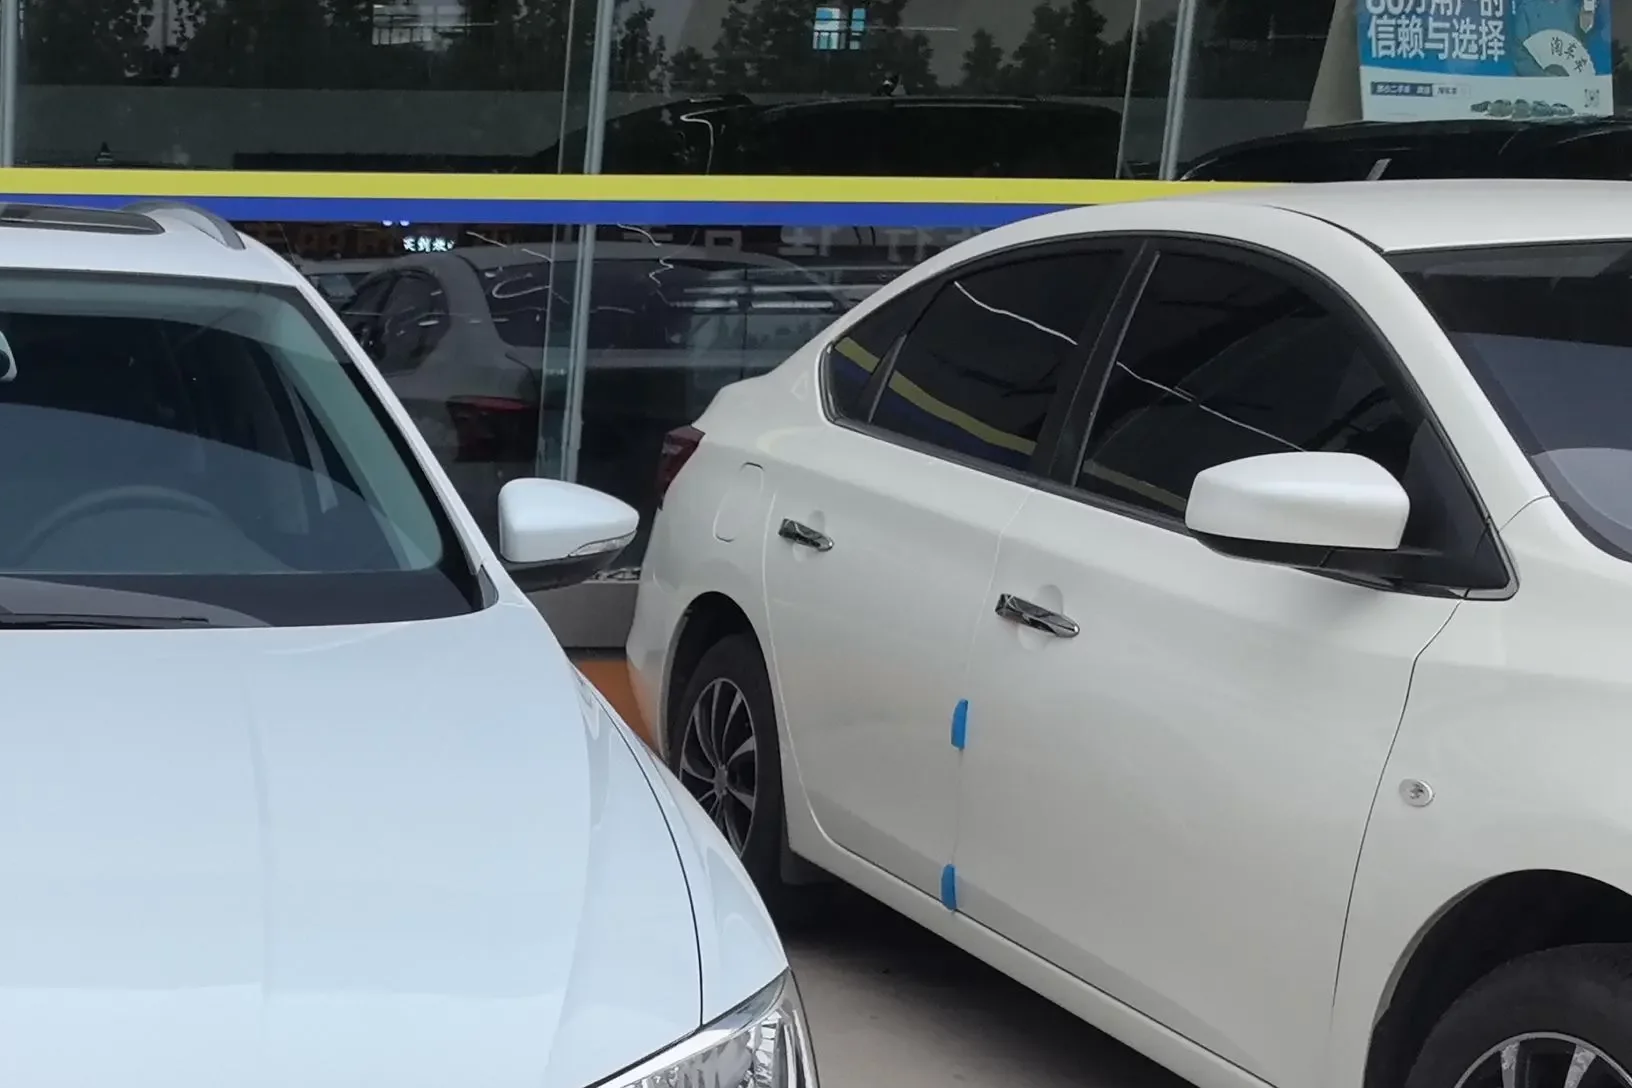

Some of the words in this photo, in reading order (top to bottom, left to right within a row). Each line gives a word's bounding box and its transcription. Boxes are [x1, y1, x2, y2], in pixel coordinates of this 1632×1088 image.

[1367, 15, 1506, 62] 信赖与选择
